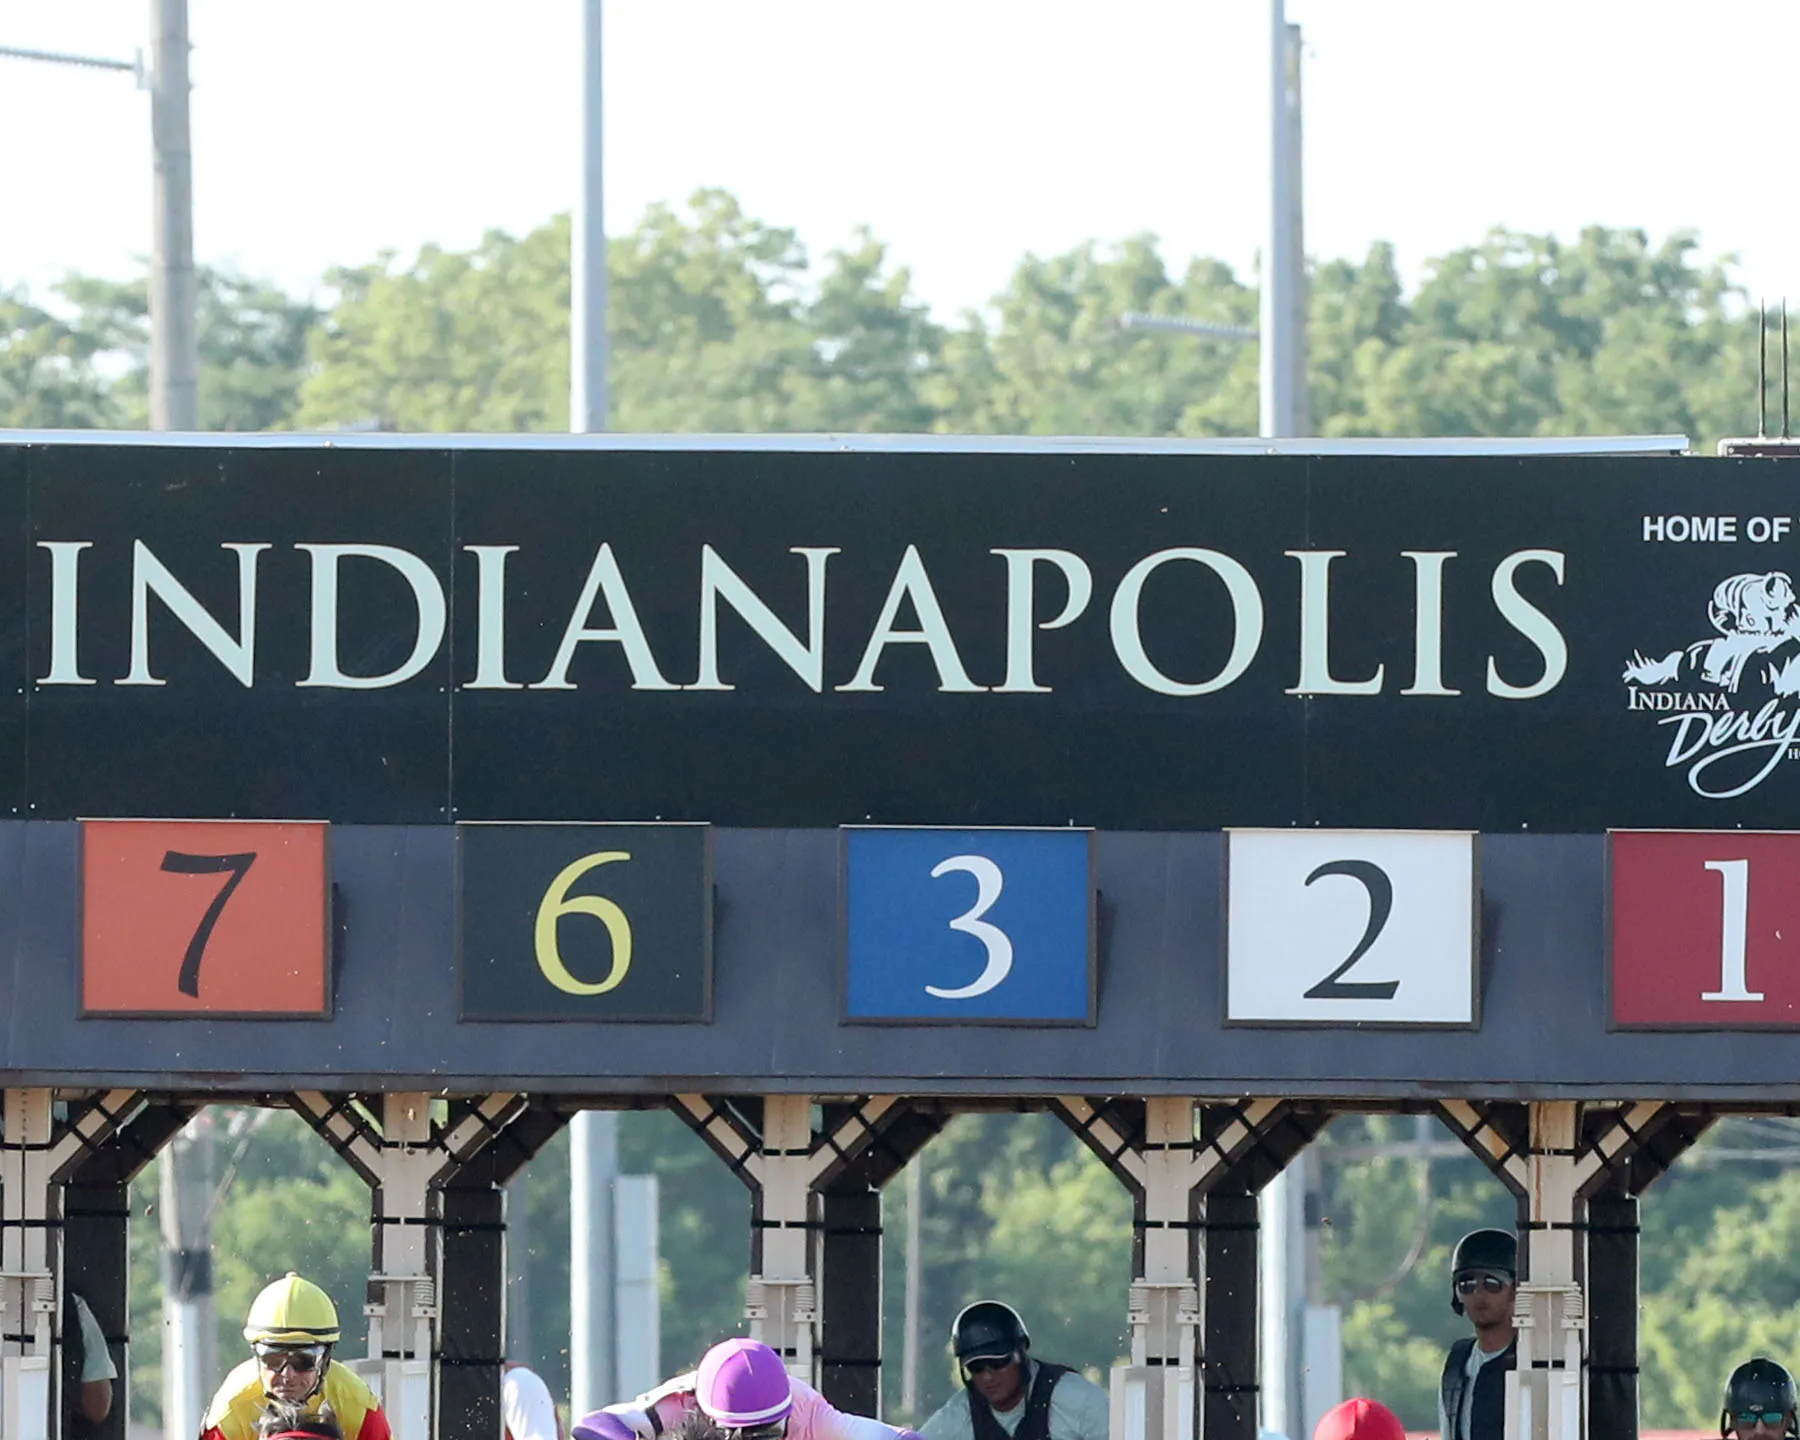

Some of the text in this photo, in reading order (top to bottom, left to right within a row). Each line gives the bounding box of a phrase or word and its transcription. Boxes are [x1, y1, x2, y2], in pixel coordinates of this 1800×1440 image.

[1643, 515, 1737, 542] HOME
[1746, 516, 1792, 543] OF
[36, 538, 1568, 699] INDIANAPOLIS
[1627, 686, 1731, 711] INDIANA
[1657, 699, 1800, 799] Derby
[159, 850, 258, 998] 7
[534, 851, 632, 996] 6
[924, 854, 1013, 999] 3
[1302, 859, 1401, 1001] 2
[1701, 858, 1765, 1002] 1
